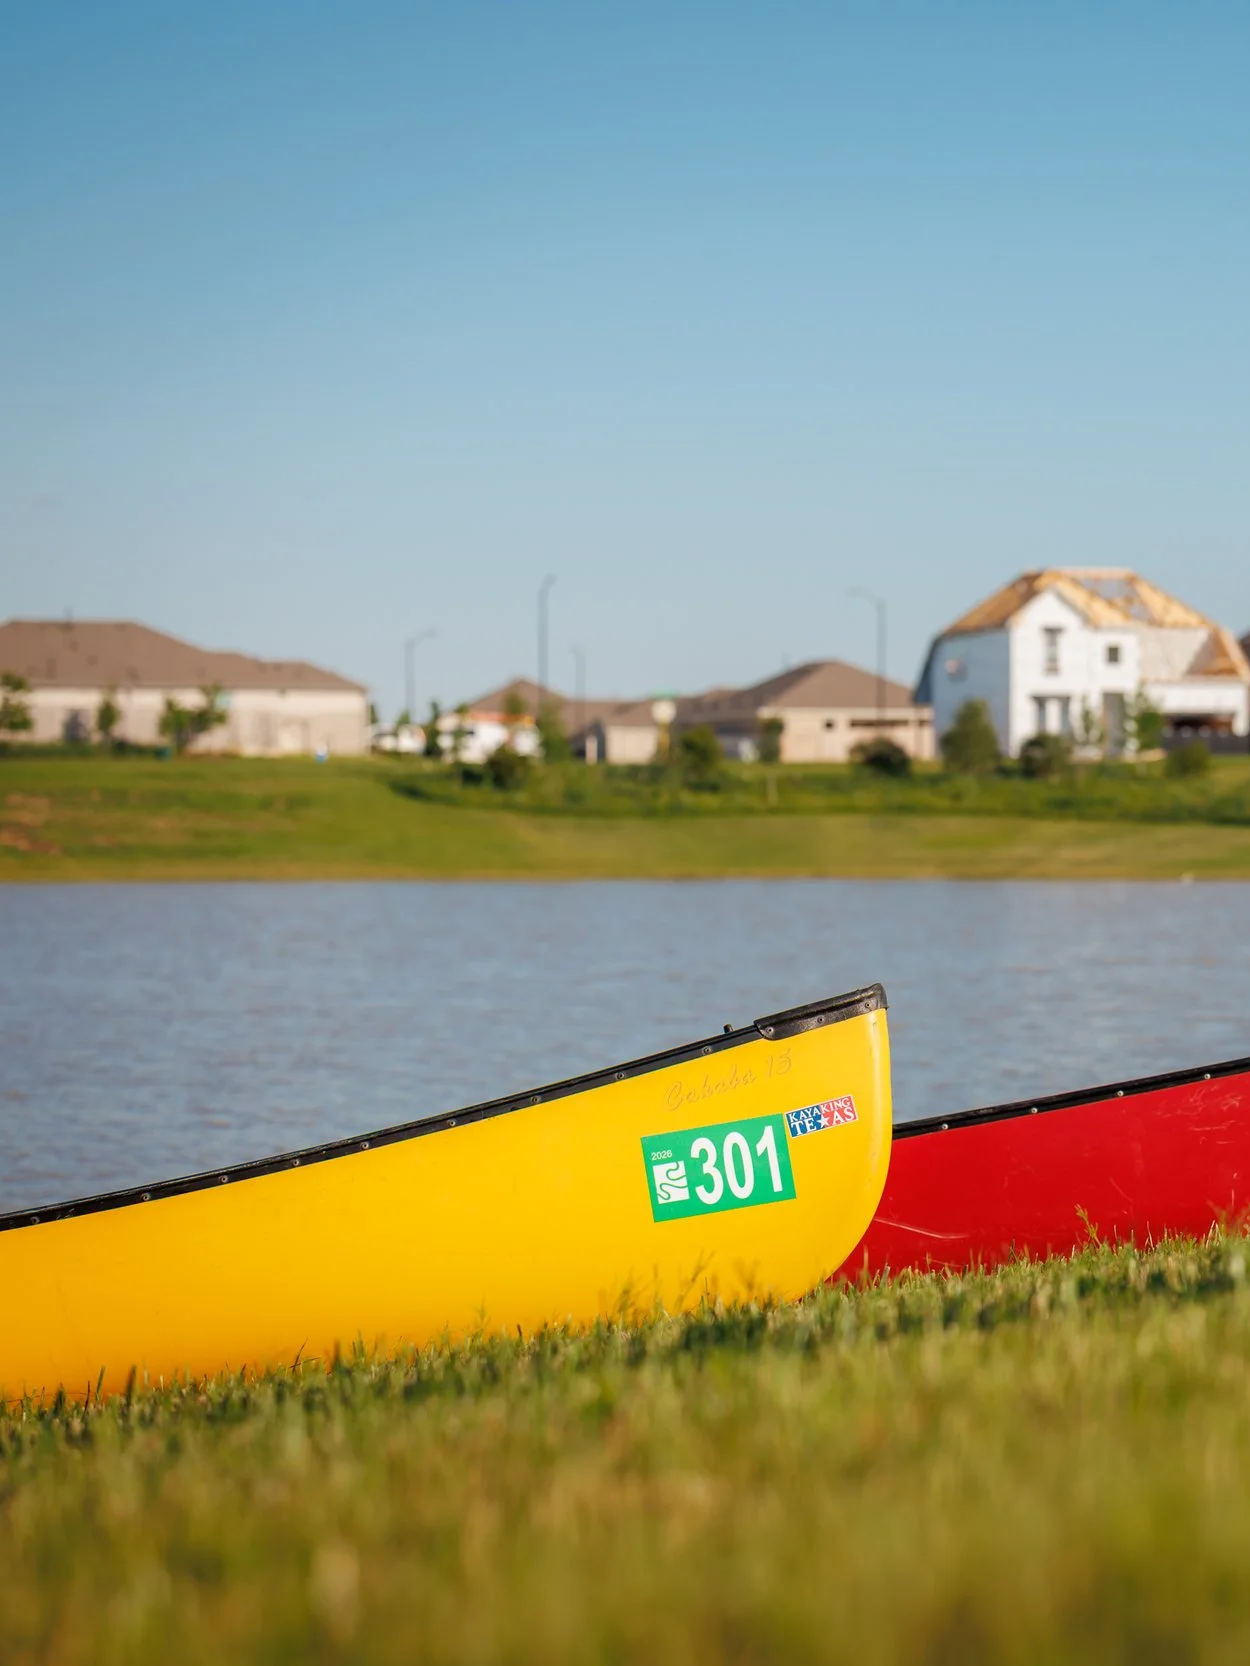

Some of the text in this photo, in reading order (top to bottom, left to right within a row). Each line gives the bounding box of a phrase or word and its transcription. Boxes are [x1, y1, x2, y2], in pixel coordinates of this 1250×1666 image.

[789, 1097, 851, 1123] KAYAKING
[791, 1107, 855, 1136] TEAS
[690, 1125, 783, 1205] 301
